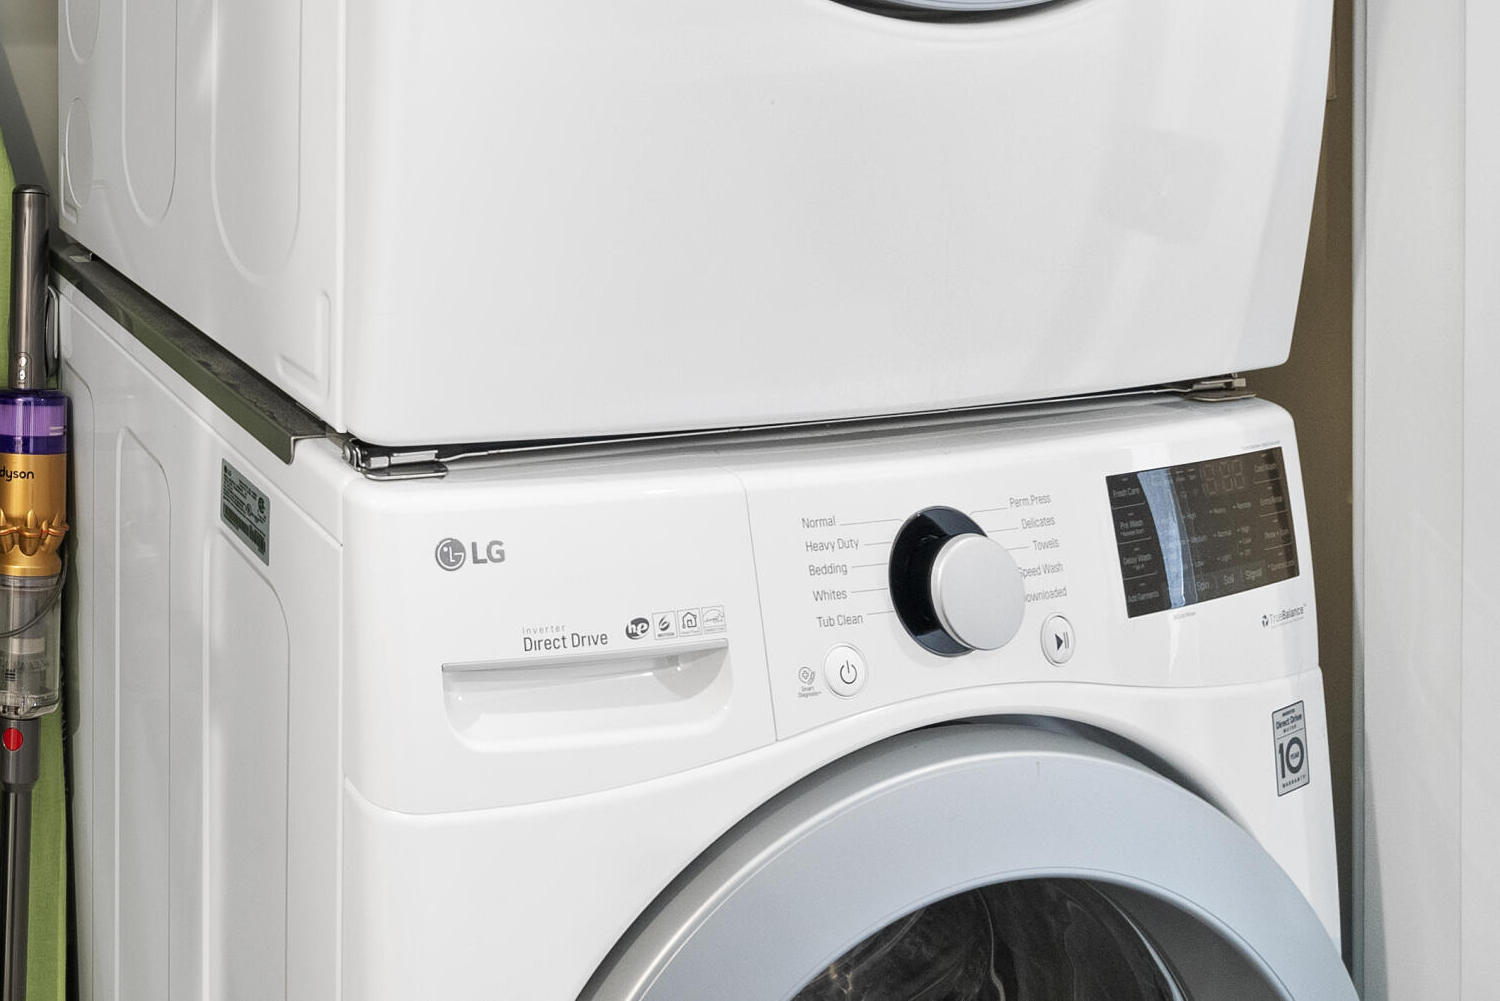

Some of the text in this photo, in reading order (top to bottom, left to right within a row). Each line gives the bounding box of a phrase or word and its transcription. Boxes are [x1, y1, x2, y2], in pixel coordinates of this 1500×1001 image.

[801, 515, 837, 529] Normal
[1021, 516, 1056, 530] Delicates
[805, 537, 860, 553] Heavy Duty
[1032, 538, 1060, 551] Towels
[471, 540, 506, 565] LG
[808, 563, 848, 576] Bedding
[1041, 561, 1064, 575] Wash
[812, 589, 848, 602] Whites
[1024, 585, 1068, 603] ownloaded
[816, 614, 864, 628] Tub Clean
[522, 624, 567, 635] Inverter
[523, 632, 609, 652] Direct Drive
[1278, 736, 1305, 780] 10
